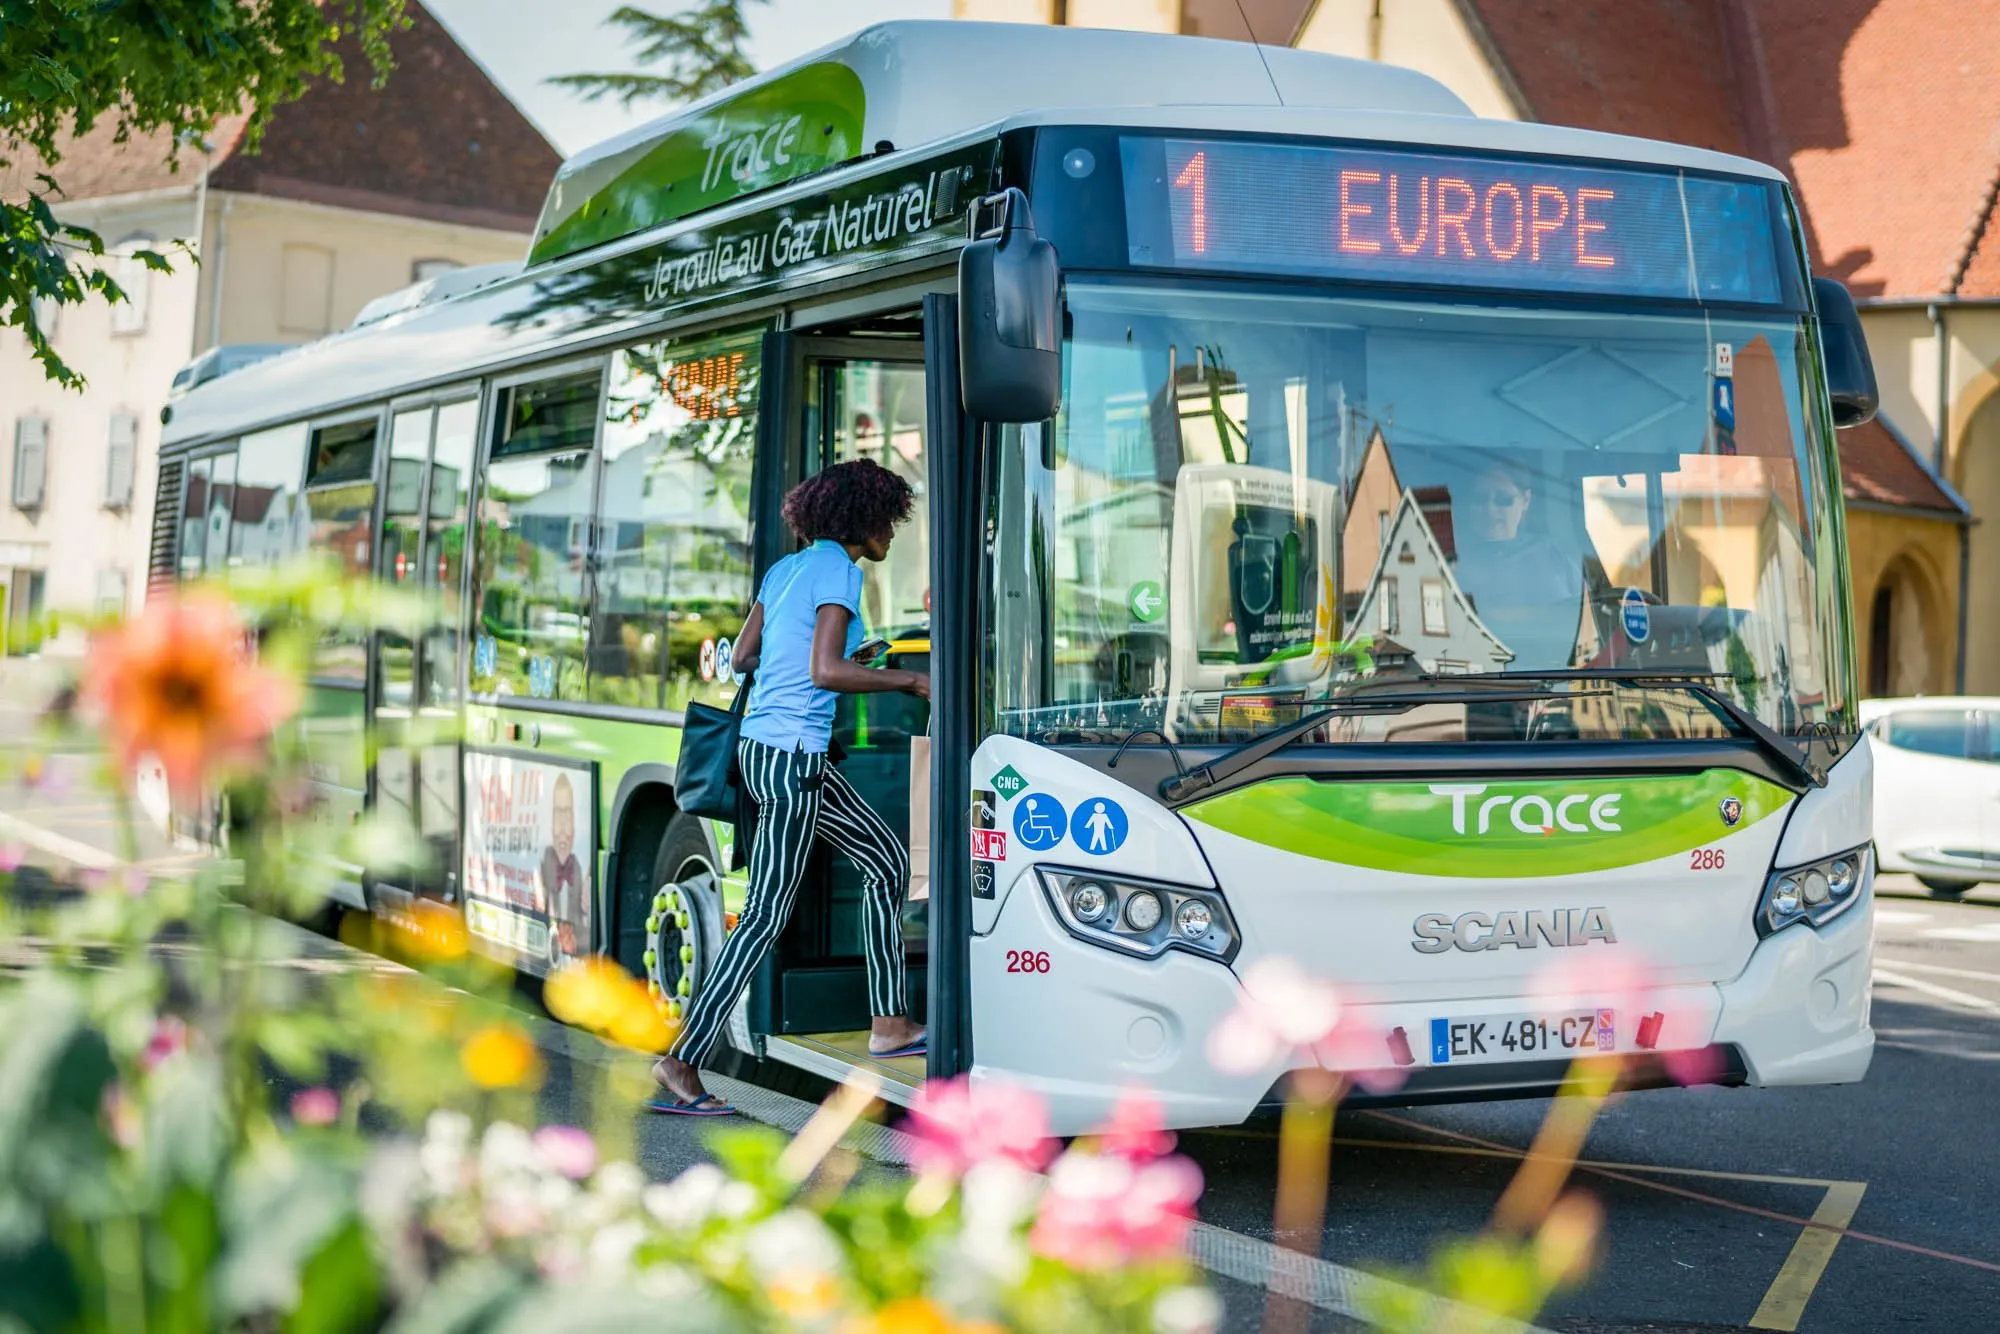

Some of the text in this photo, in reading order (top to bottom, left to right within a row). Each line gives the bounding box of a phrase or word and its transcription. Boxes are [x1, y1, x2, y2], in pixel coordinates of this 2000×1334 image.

[1174, 151, 1616, 267] 1 EUROPE
[643, 171, 936, 302] Je roule au Gaz Naturel
[997, 776, 1020, 791] CNG
[1690, 848, 1725, 870] 286
[1411, 906, 1618, 954] SCANIA
[1006, 950, 1050, 974] 286
[1437, 1044, 1444, 1056] F
